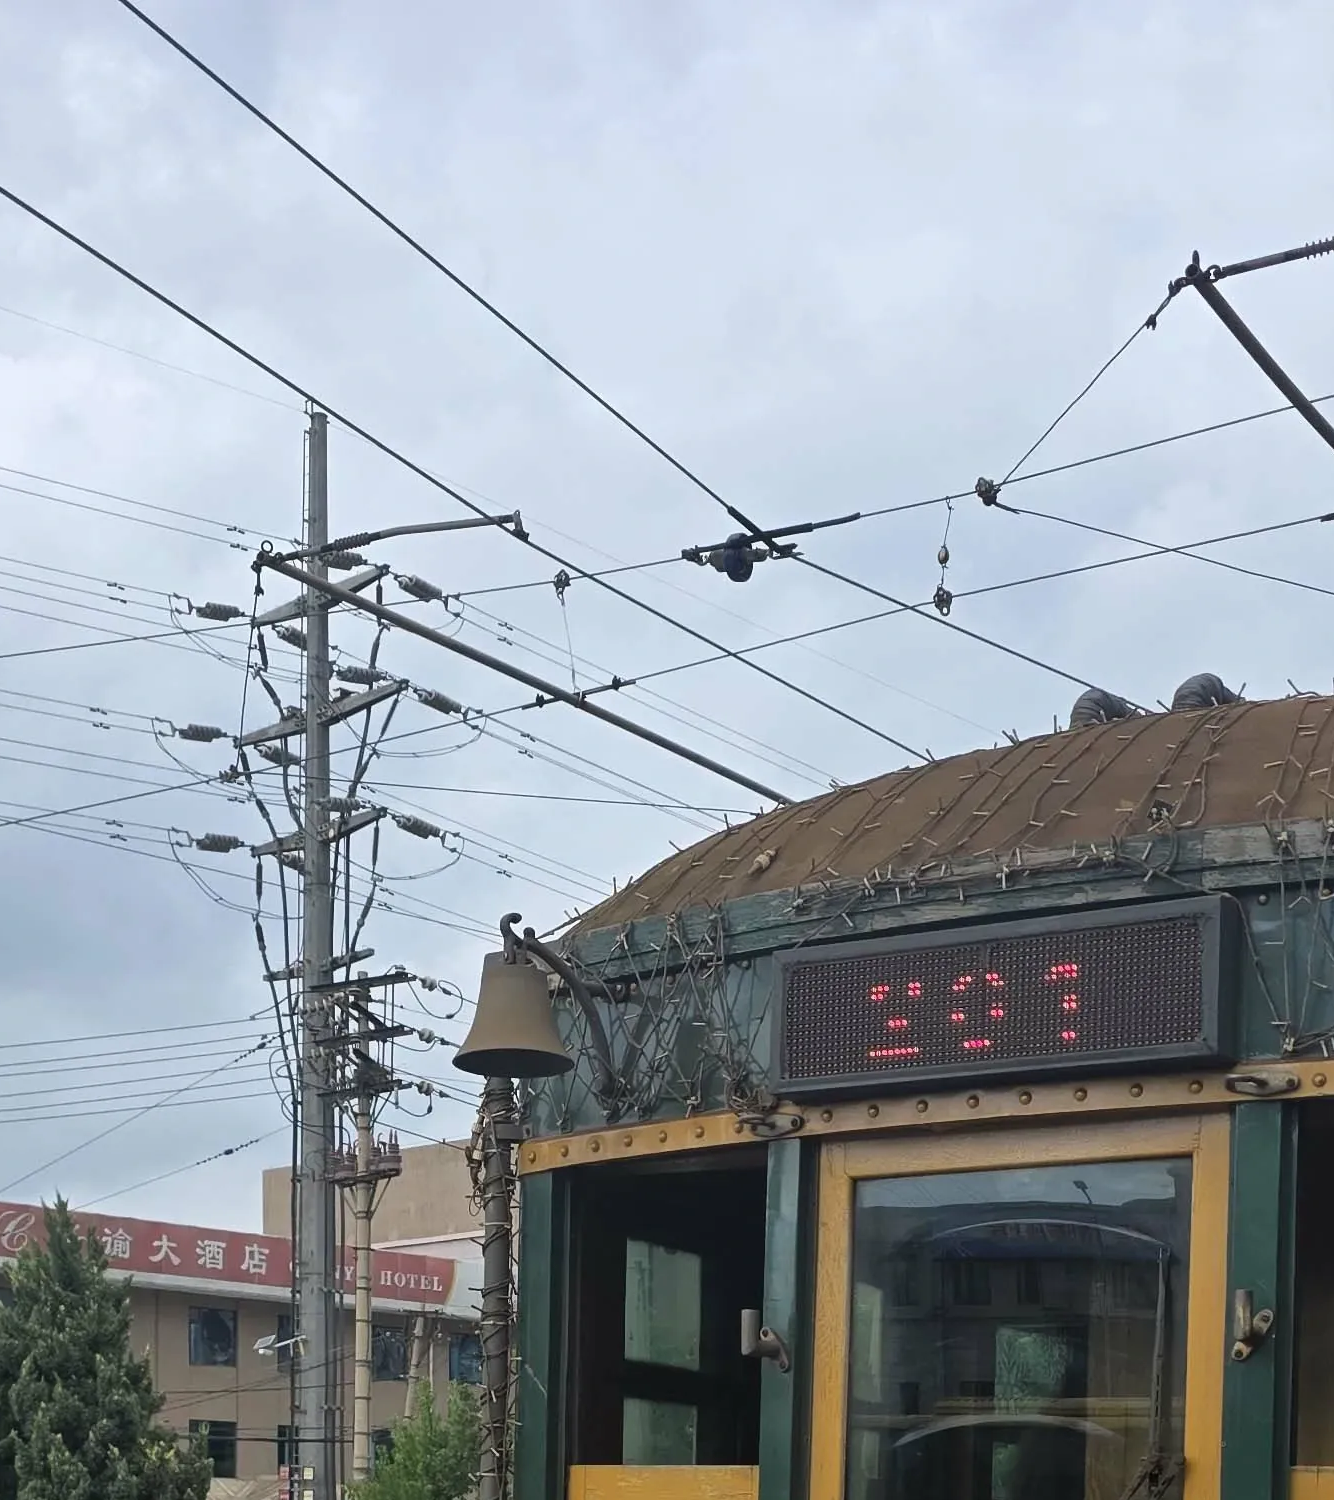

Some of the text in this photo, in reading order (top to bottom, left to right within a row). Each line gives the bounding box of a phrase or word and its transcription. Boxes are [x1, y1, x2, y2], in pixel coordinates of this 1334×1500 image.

[67, 1223, 270, 1275] 谕大酒店
[380, 1270, 443, 1292] HOTEL
